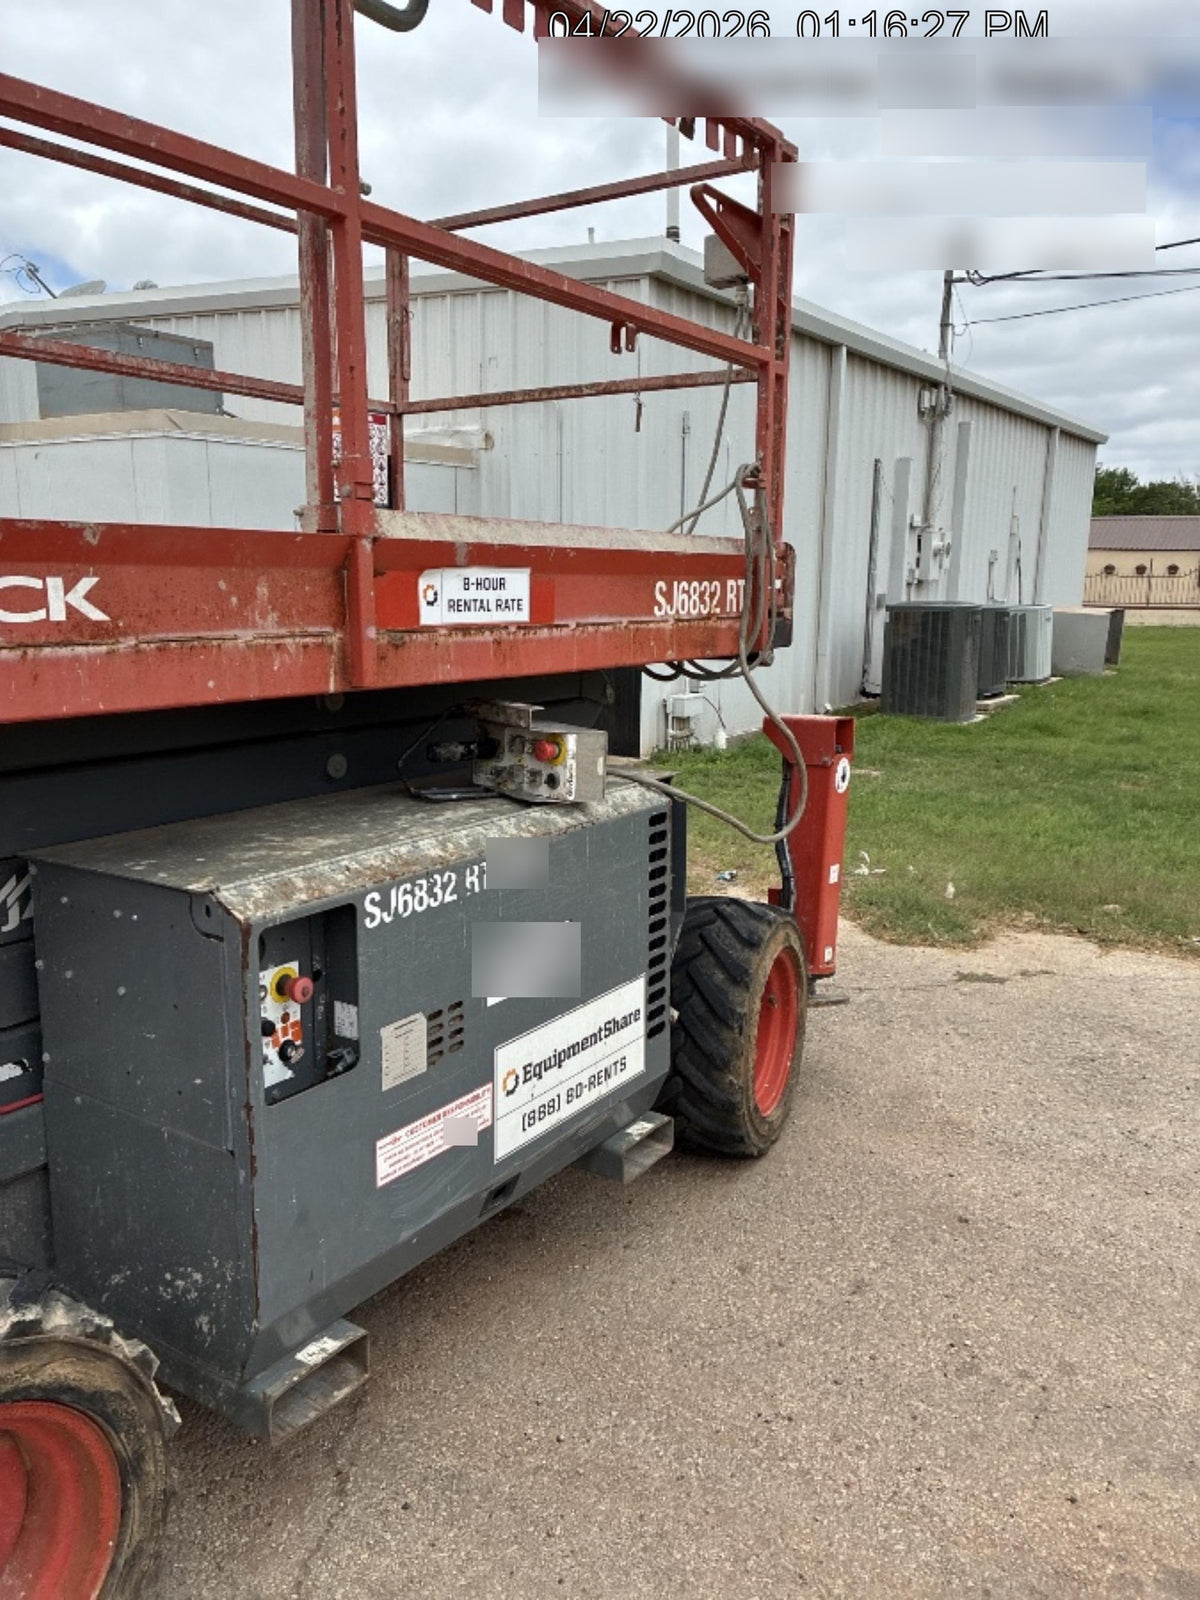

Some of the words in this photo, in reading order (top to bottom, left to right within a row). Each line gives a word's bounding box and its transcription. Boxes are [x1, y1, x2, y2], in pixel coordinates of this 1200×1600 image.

[448, 598, 491, 612] RENTAL
[496, 598, 523, 612] RATE
[653, 580, 721, 616] SJ6832
[363, 870, 458, 929] SJ6832
[522, 1008, 641, 1084] EquipmentShare
[522, 1094, 561, 1132] (888)
